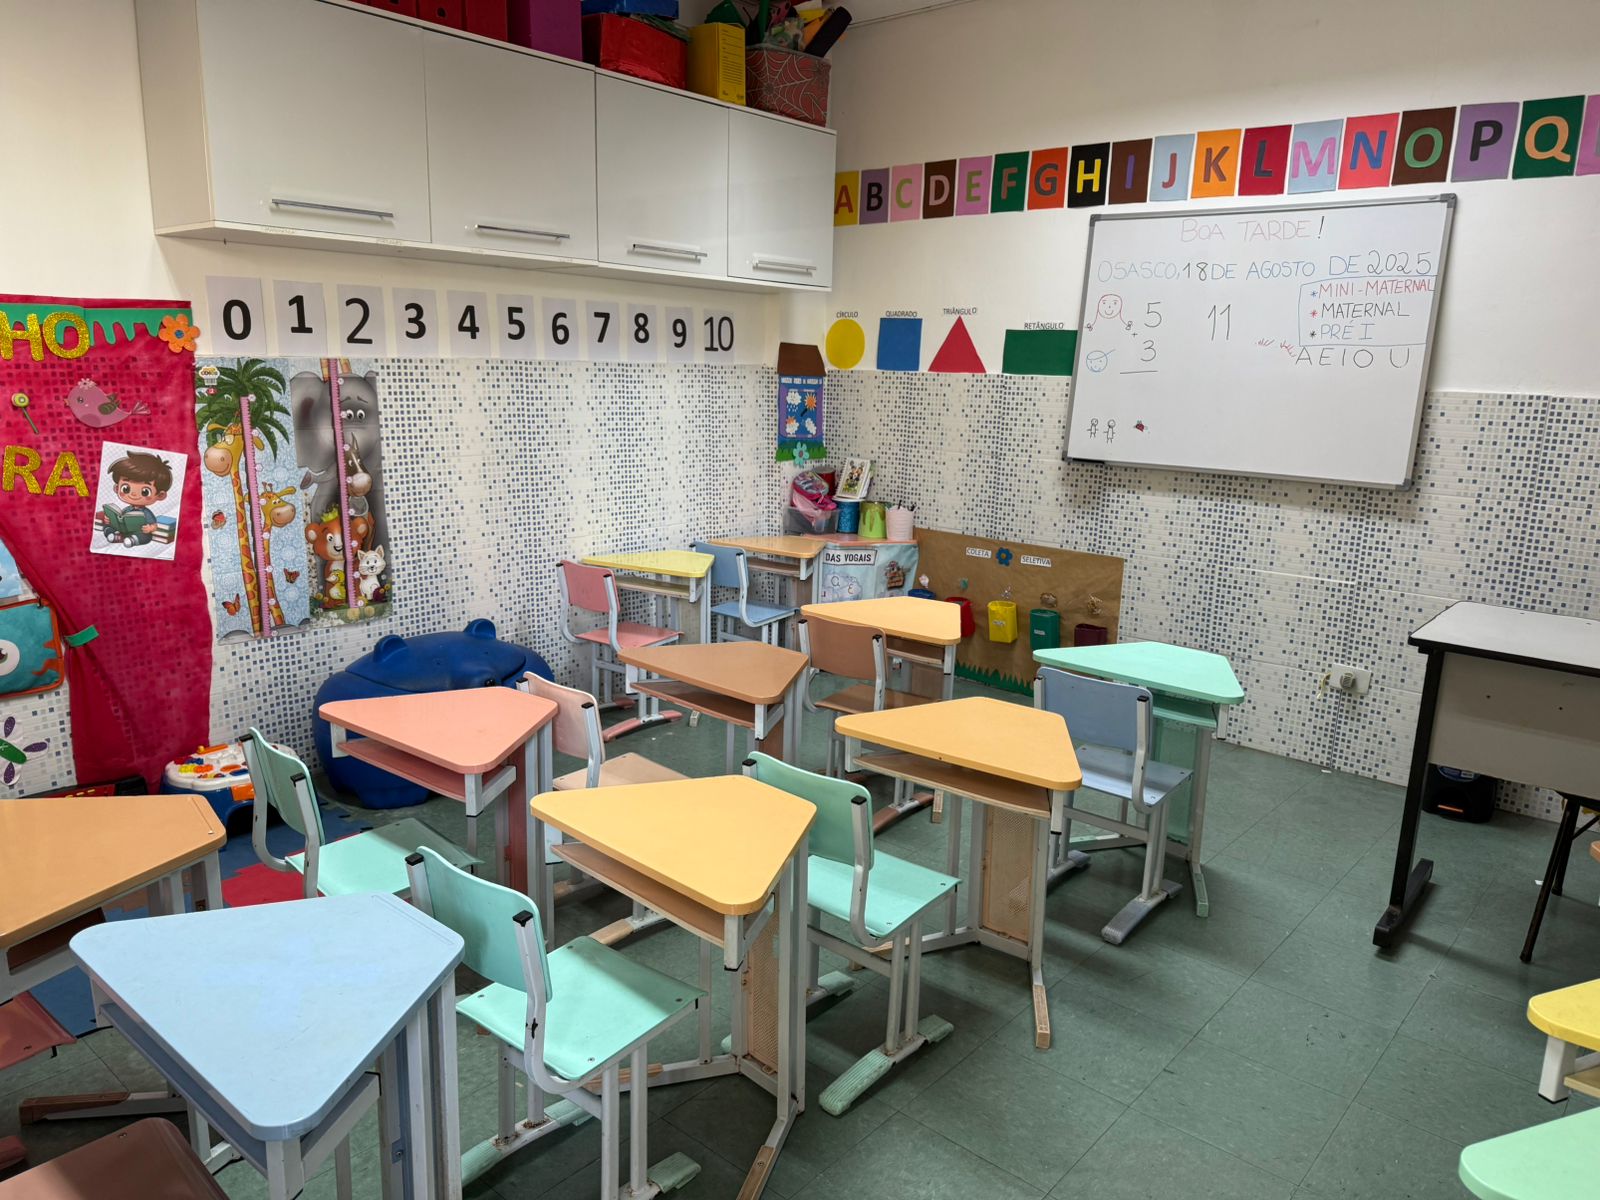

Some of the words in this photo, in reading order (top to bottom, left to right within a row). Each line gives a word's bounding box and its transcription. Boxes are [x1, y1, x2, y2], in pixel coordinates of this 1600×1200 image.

[834, 185, 854, 214] A
[866, 182, 883, 212] B
[896, 178, 913, 208] C
[929, 175, 950, 206] D
[966, 170, 982, 202] E
[1001, 167, 1018, 200] F
[1034, 163, 1059, 196] G
[1076, 158, 1101, 193] H
[1124, 154, 1135, 189] I
[1162, 153, 1178, 189] J
[1203, 146, 1229, 182] K
[1254, 140, 1273, 177] L
[1291, 136, 1337, 179] M
[1350, 131, 1387, 170] N
[1404, 127, 1444, 168] O
[1469, 120, 1503, 161] P
[1525, 115, 1571, 162] Q
[1180, 218, 1225, 242] BOA
[1211, 263, 1238, 280] DE
[1246, 260, 1315, 280] AGOSTO
[1329, 255, 1361, 275] DE
[1367, 250, 1432, 275] 2025
[222, 299, 251, 340] 0
[288, 294, 313, 334] 1
[345, 297, 373, 344] 2
[404, 302, 426, 339] 3
[458, 305, 479, 339] 4
[507, 306, 525, 340] 5
[552, 312, 570, 345] 6
[594, 312, 610, 343] 7
[634, 312, 650, 344] 8
[672, 318, 687, 348] 9
[704, 316, 734, 351] 10
[885, 310, 918, 318] QUADRADO
[1144, 301, 1162, 327] 5
[1208, 303, 1231, 341] 11
[1321, 302, 1411, 319] MATERNAL
[1320, 320, 1354, 340] PRÉ
[1140, 339, 1157, 362] 3
[3, 445, 90, 497] RA
[825, 553, 841, 562] DAS
[844, 553, 872, 562] VOGAIS
[1021, 556, 1051, 566] SELETIVA
